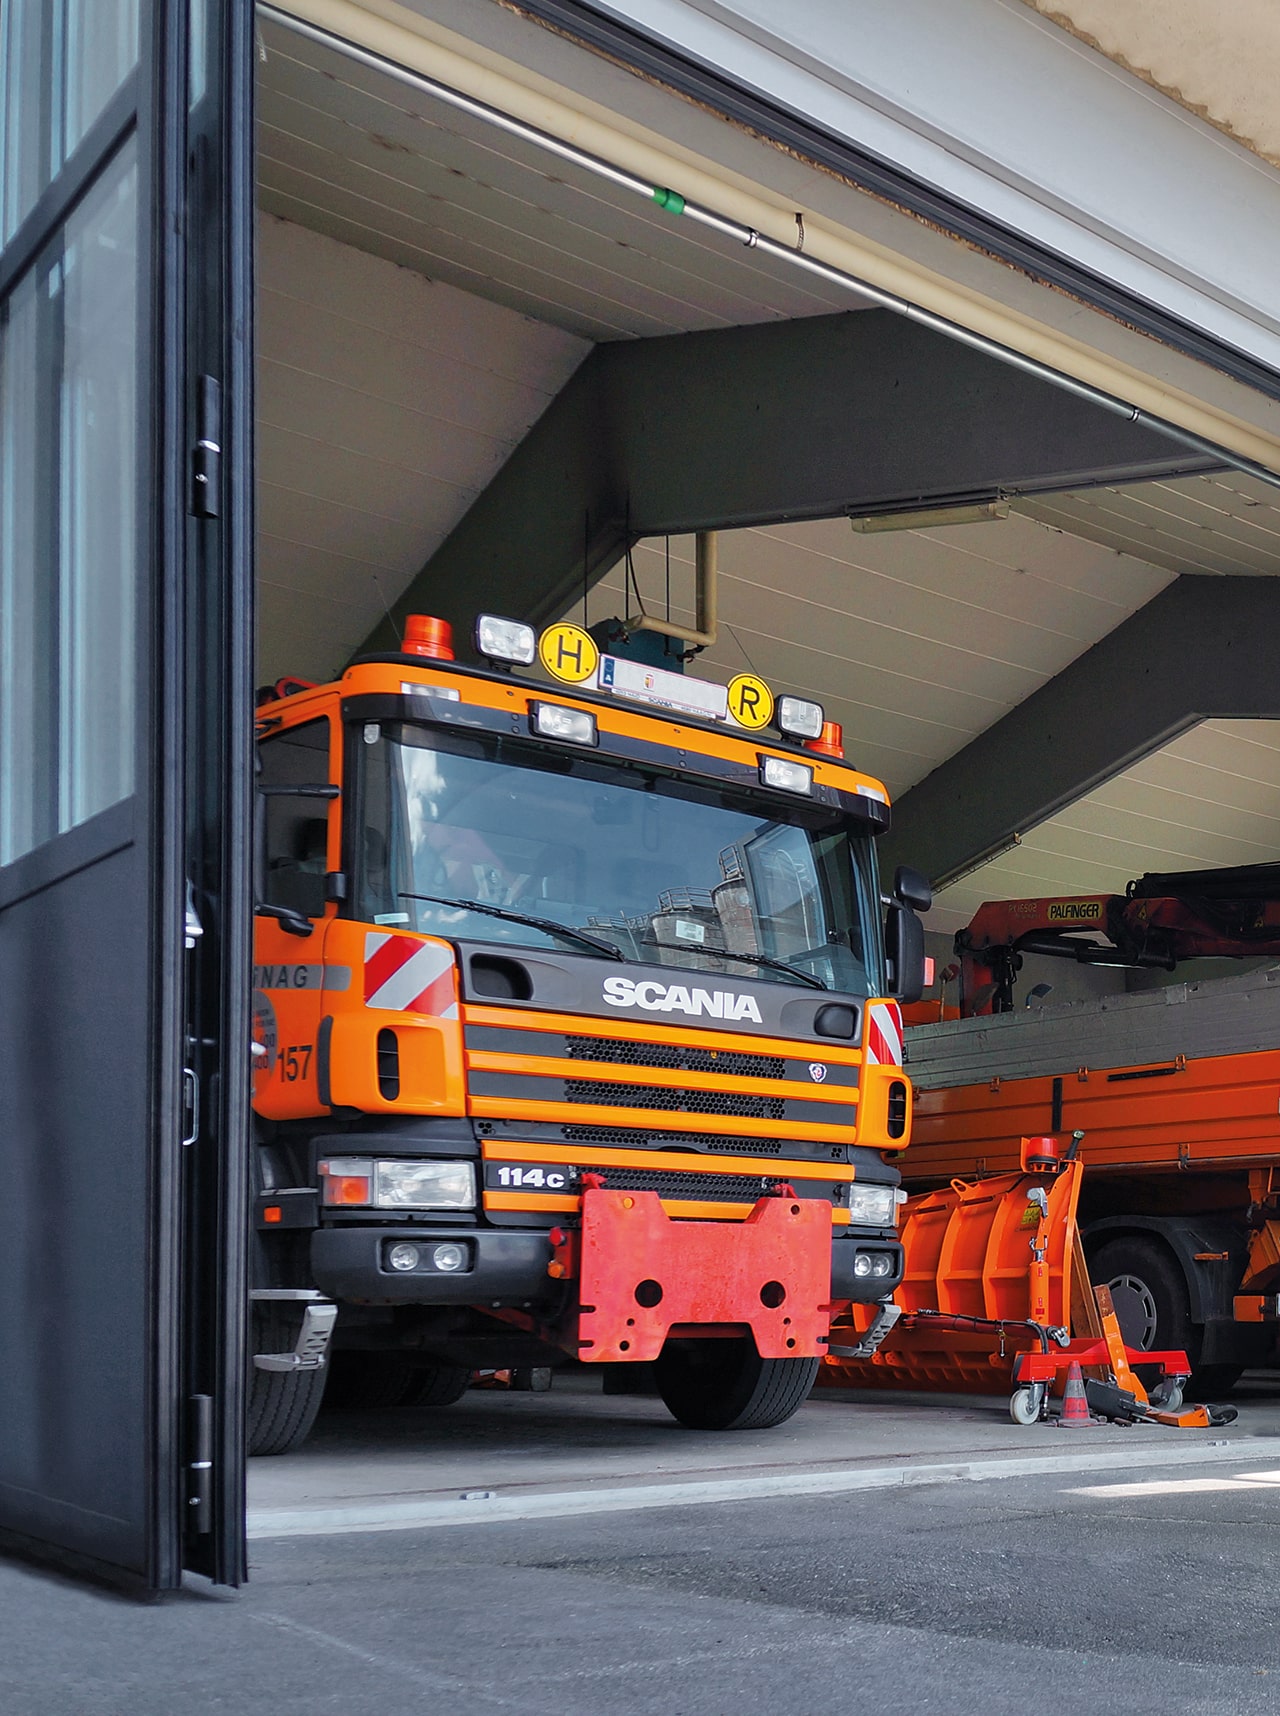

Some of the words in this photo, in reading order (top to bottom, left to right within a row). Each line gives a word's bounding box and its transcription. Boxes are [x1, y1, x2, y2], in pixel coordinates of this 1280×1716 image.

[556, 634, 582, 673] H
[739, 684, 761, 721] R
[1050, 903, 1099, 919] PALFINGER
[602, 977, 763, 1024] SCANIA
[278, 1045, 312, 1083] 157
